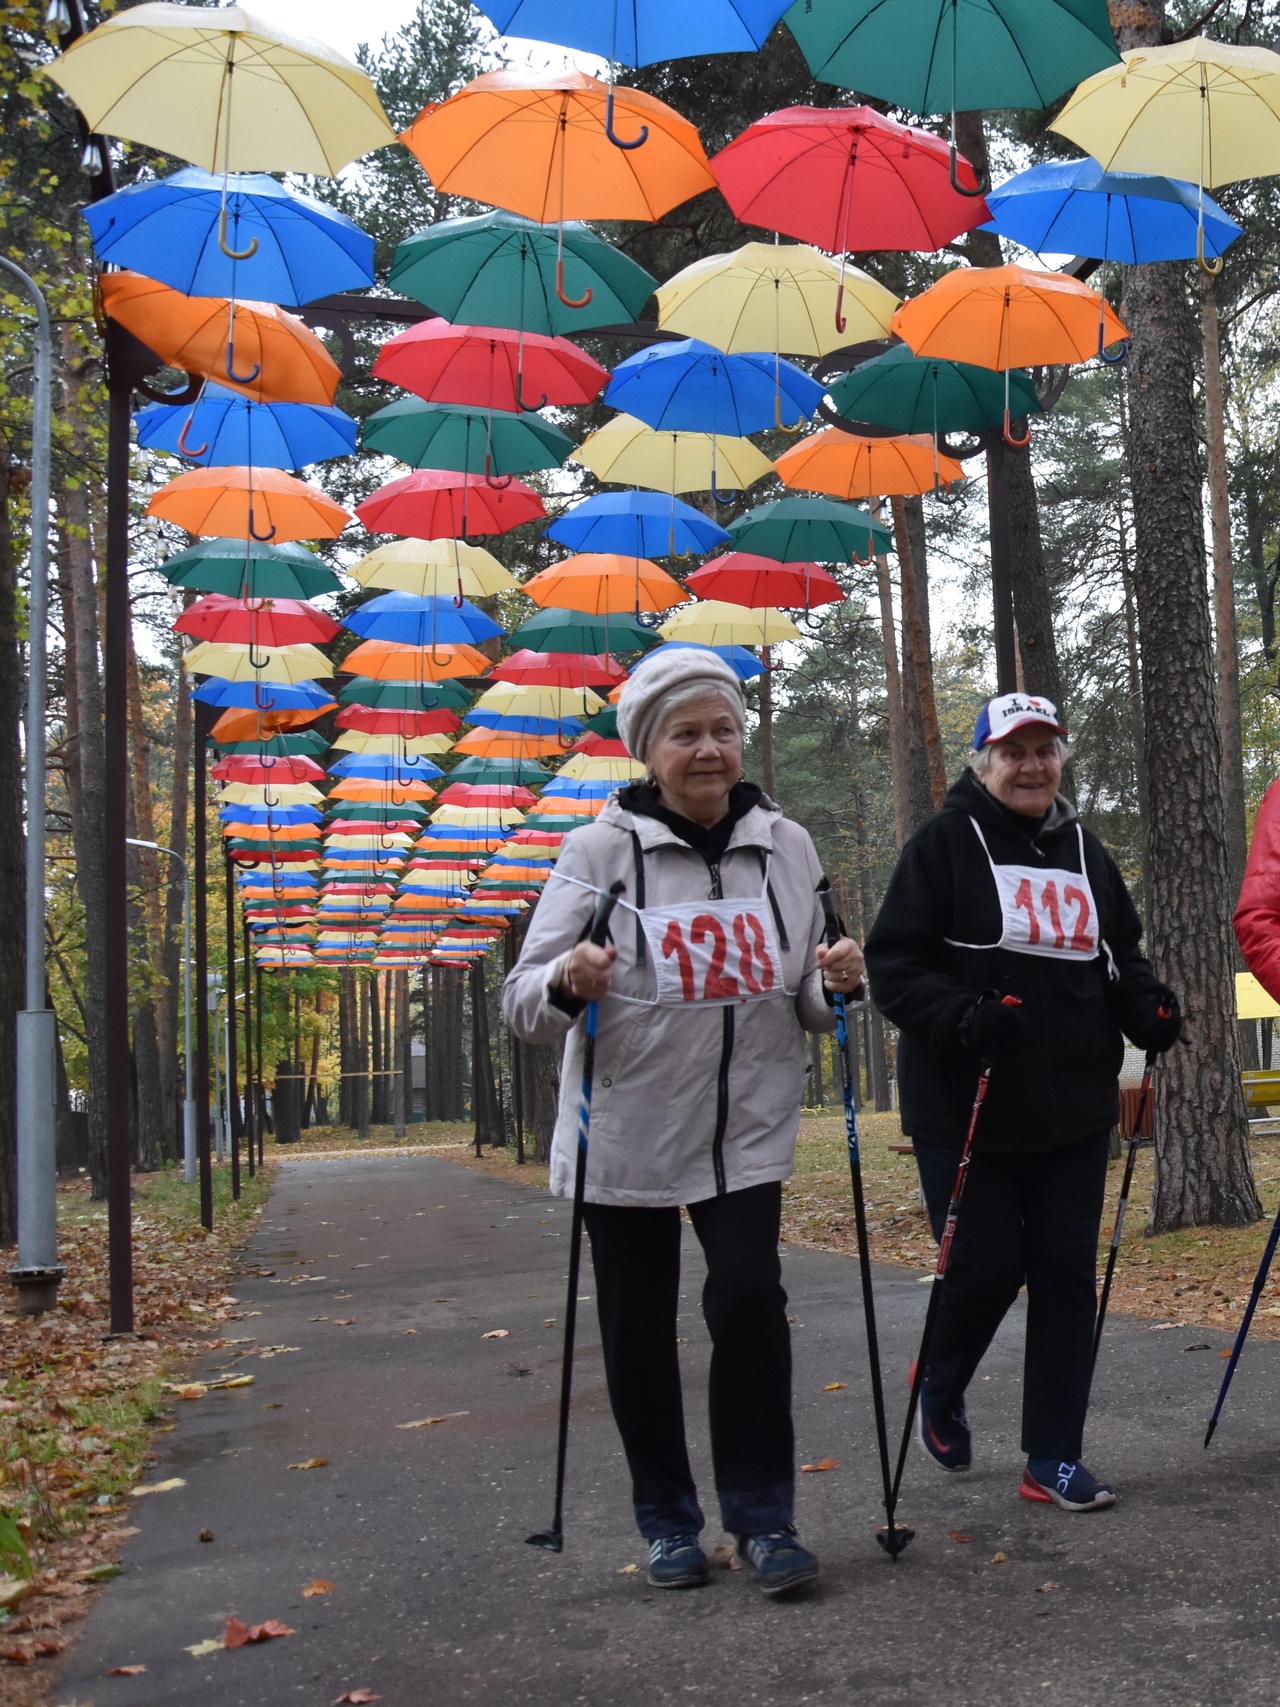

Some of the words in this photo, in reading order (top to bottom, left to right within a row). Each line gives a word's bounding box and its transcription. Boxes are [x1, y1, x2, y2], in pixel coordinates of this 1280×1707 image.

[1002, 705, 1050, 718] ISRAEL
[1009, 698, 1020, 707] I
[1014, 878, 1095, 951] 112
[661, 912, 775, 1002] 128
